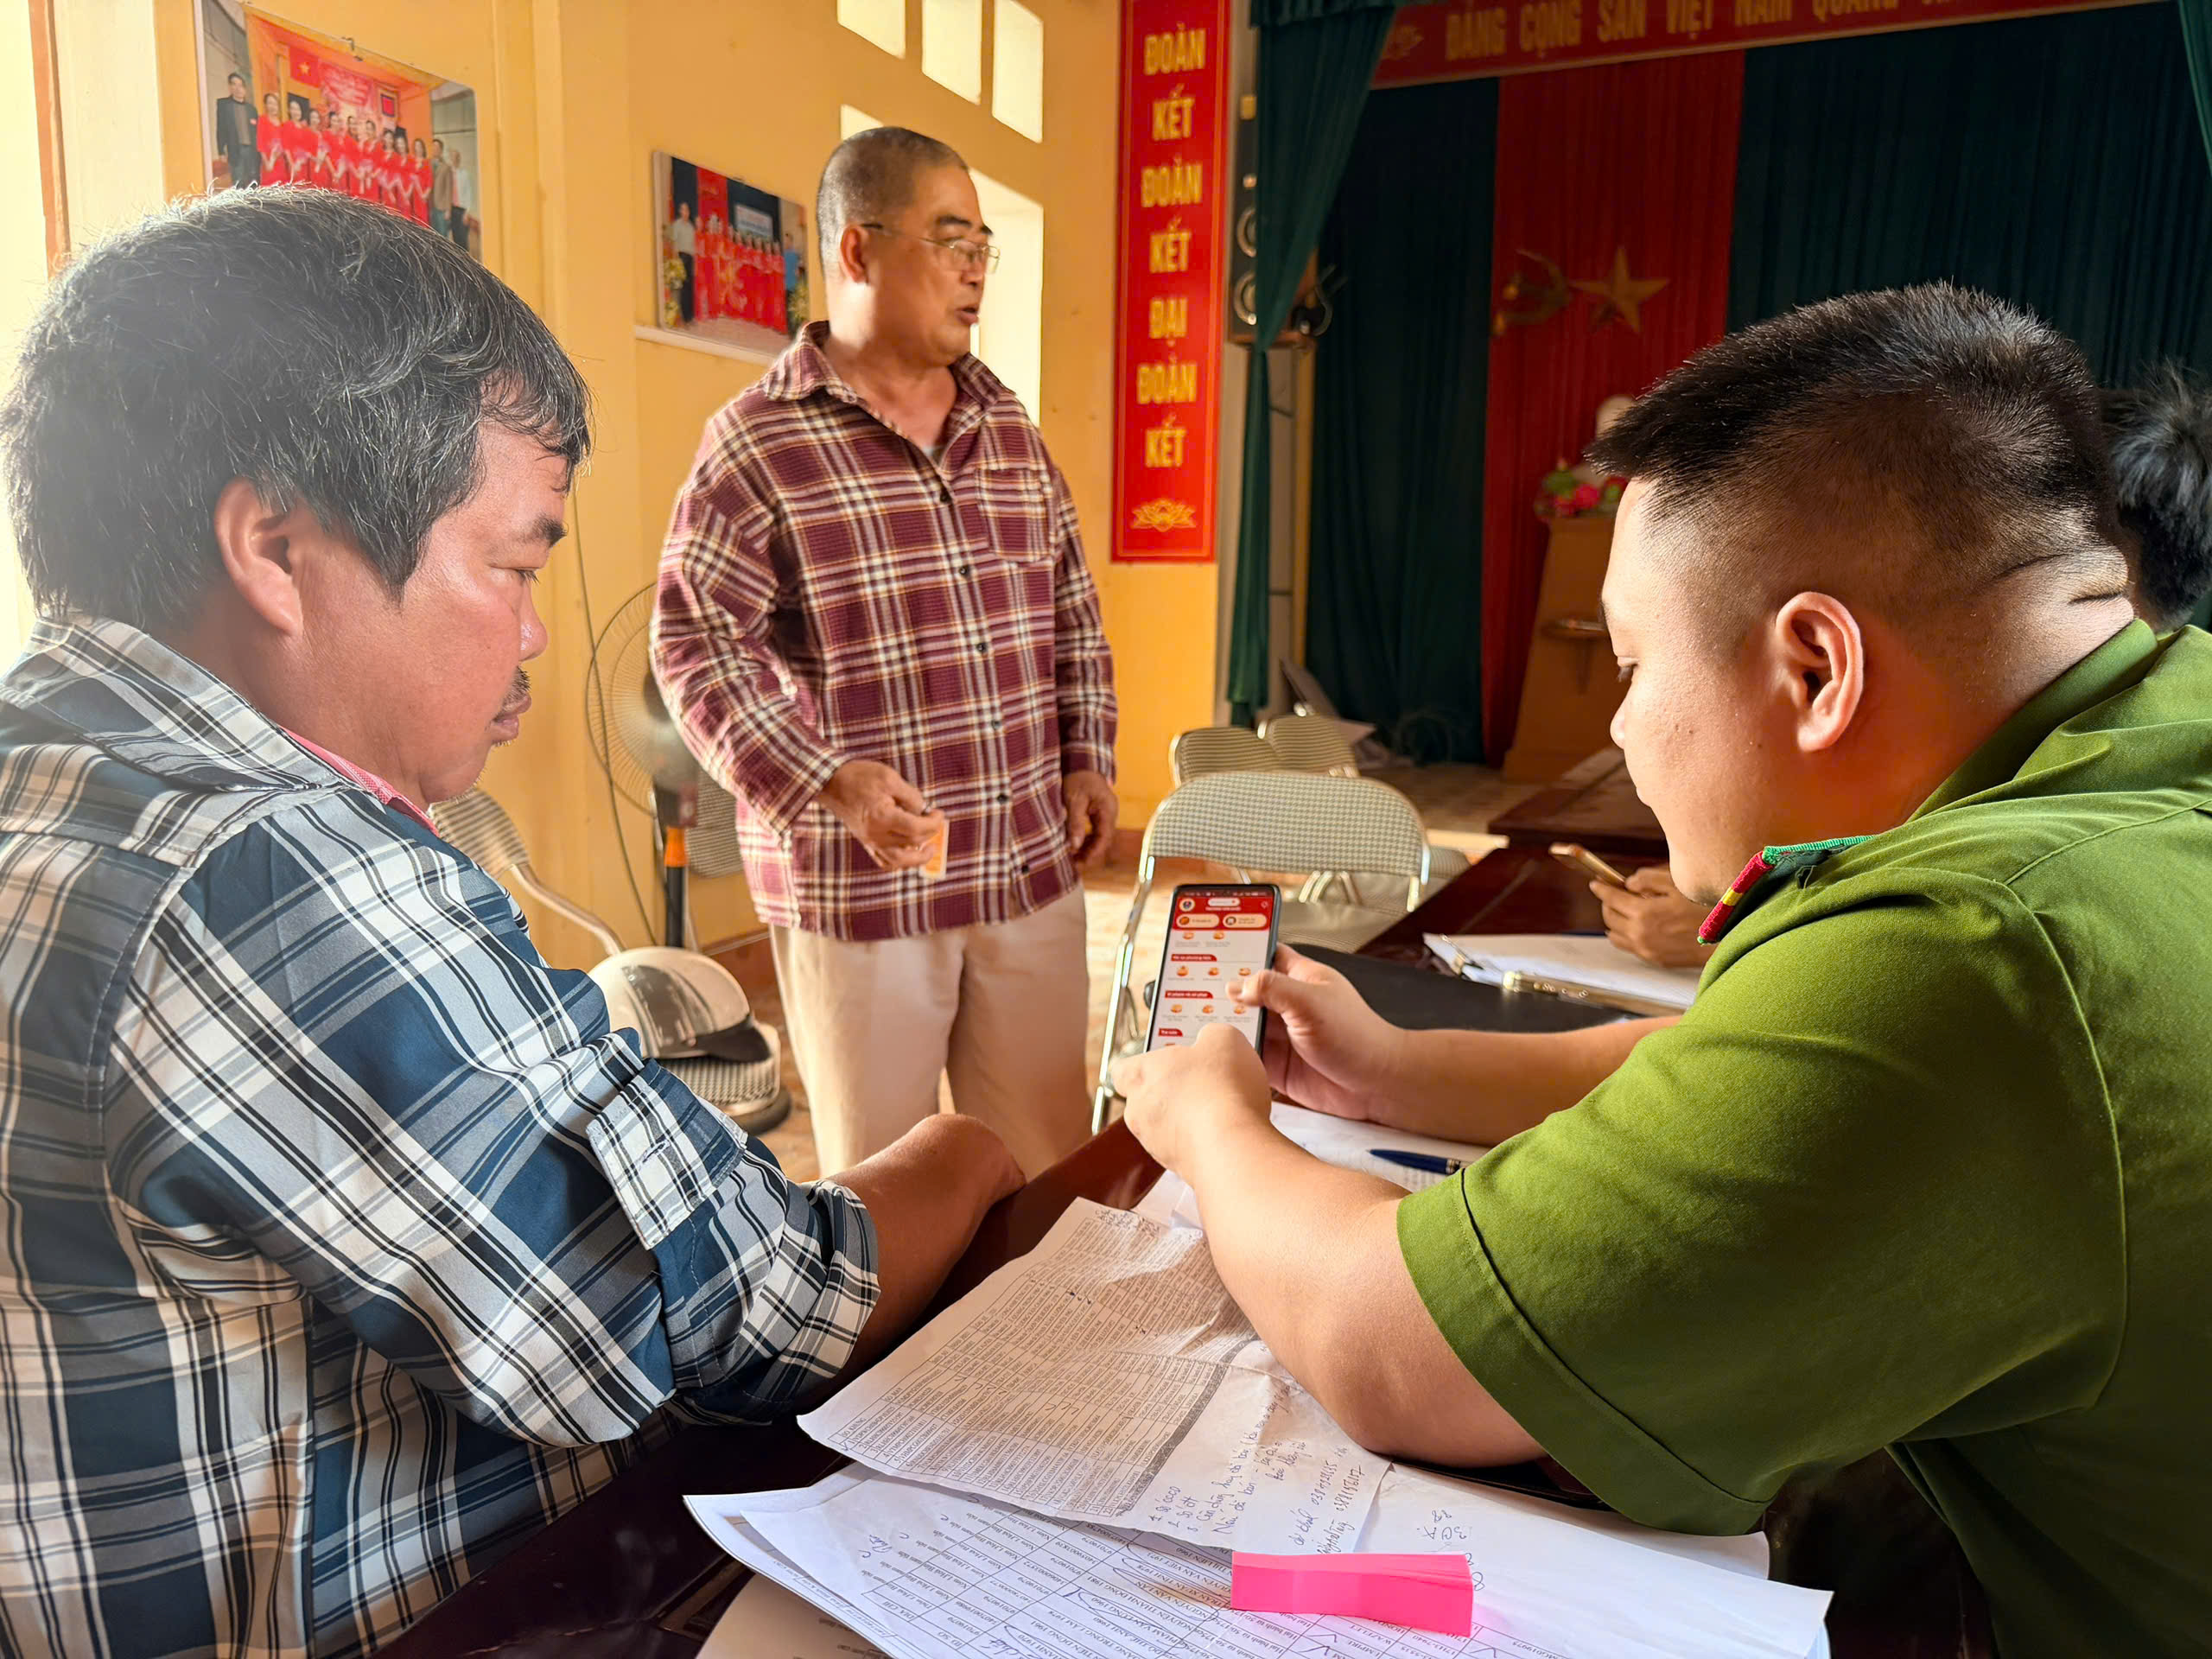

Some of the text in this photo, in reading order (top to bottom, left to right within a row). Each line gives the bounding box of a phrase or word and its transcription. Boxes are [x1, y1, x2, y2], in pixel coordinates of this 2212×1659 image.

[1144, 22, 1205, 76] ĐOÀN
[1152, 83, 1195, 141] KẾT
[1141, 156, 1203, 208] ĐOÀN
[1149, 216, 1192, 274] KẾT
[1148, 297, 1188, 346] ĐẠI
[1136, 353, 1197, 404] ĐOÀN
[1145, 413, 1186, 469] KẾT
[1147, 1552, 1163, 1561] 1973
[1175, 1547, 1193, 1557] 1960
[1086, 1575, 1103, 1586] 1981
[1199, 1576, 1232, 1595] GUYỄN
[1090, 1597, 1109, 1607] 1960
[1030, 1620, 1047, 1631] 1961
[1017, 1634, 1036, 1645] 1970
[1248, 1635, 1269, 1647] bánh
[1268, 1644, 1284, 1654] Hai
